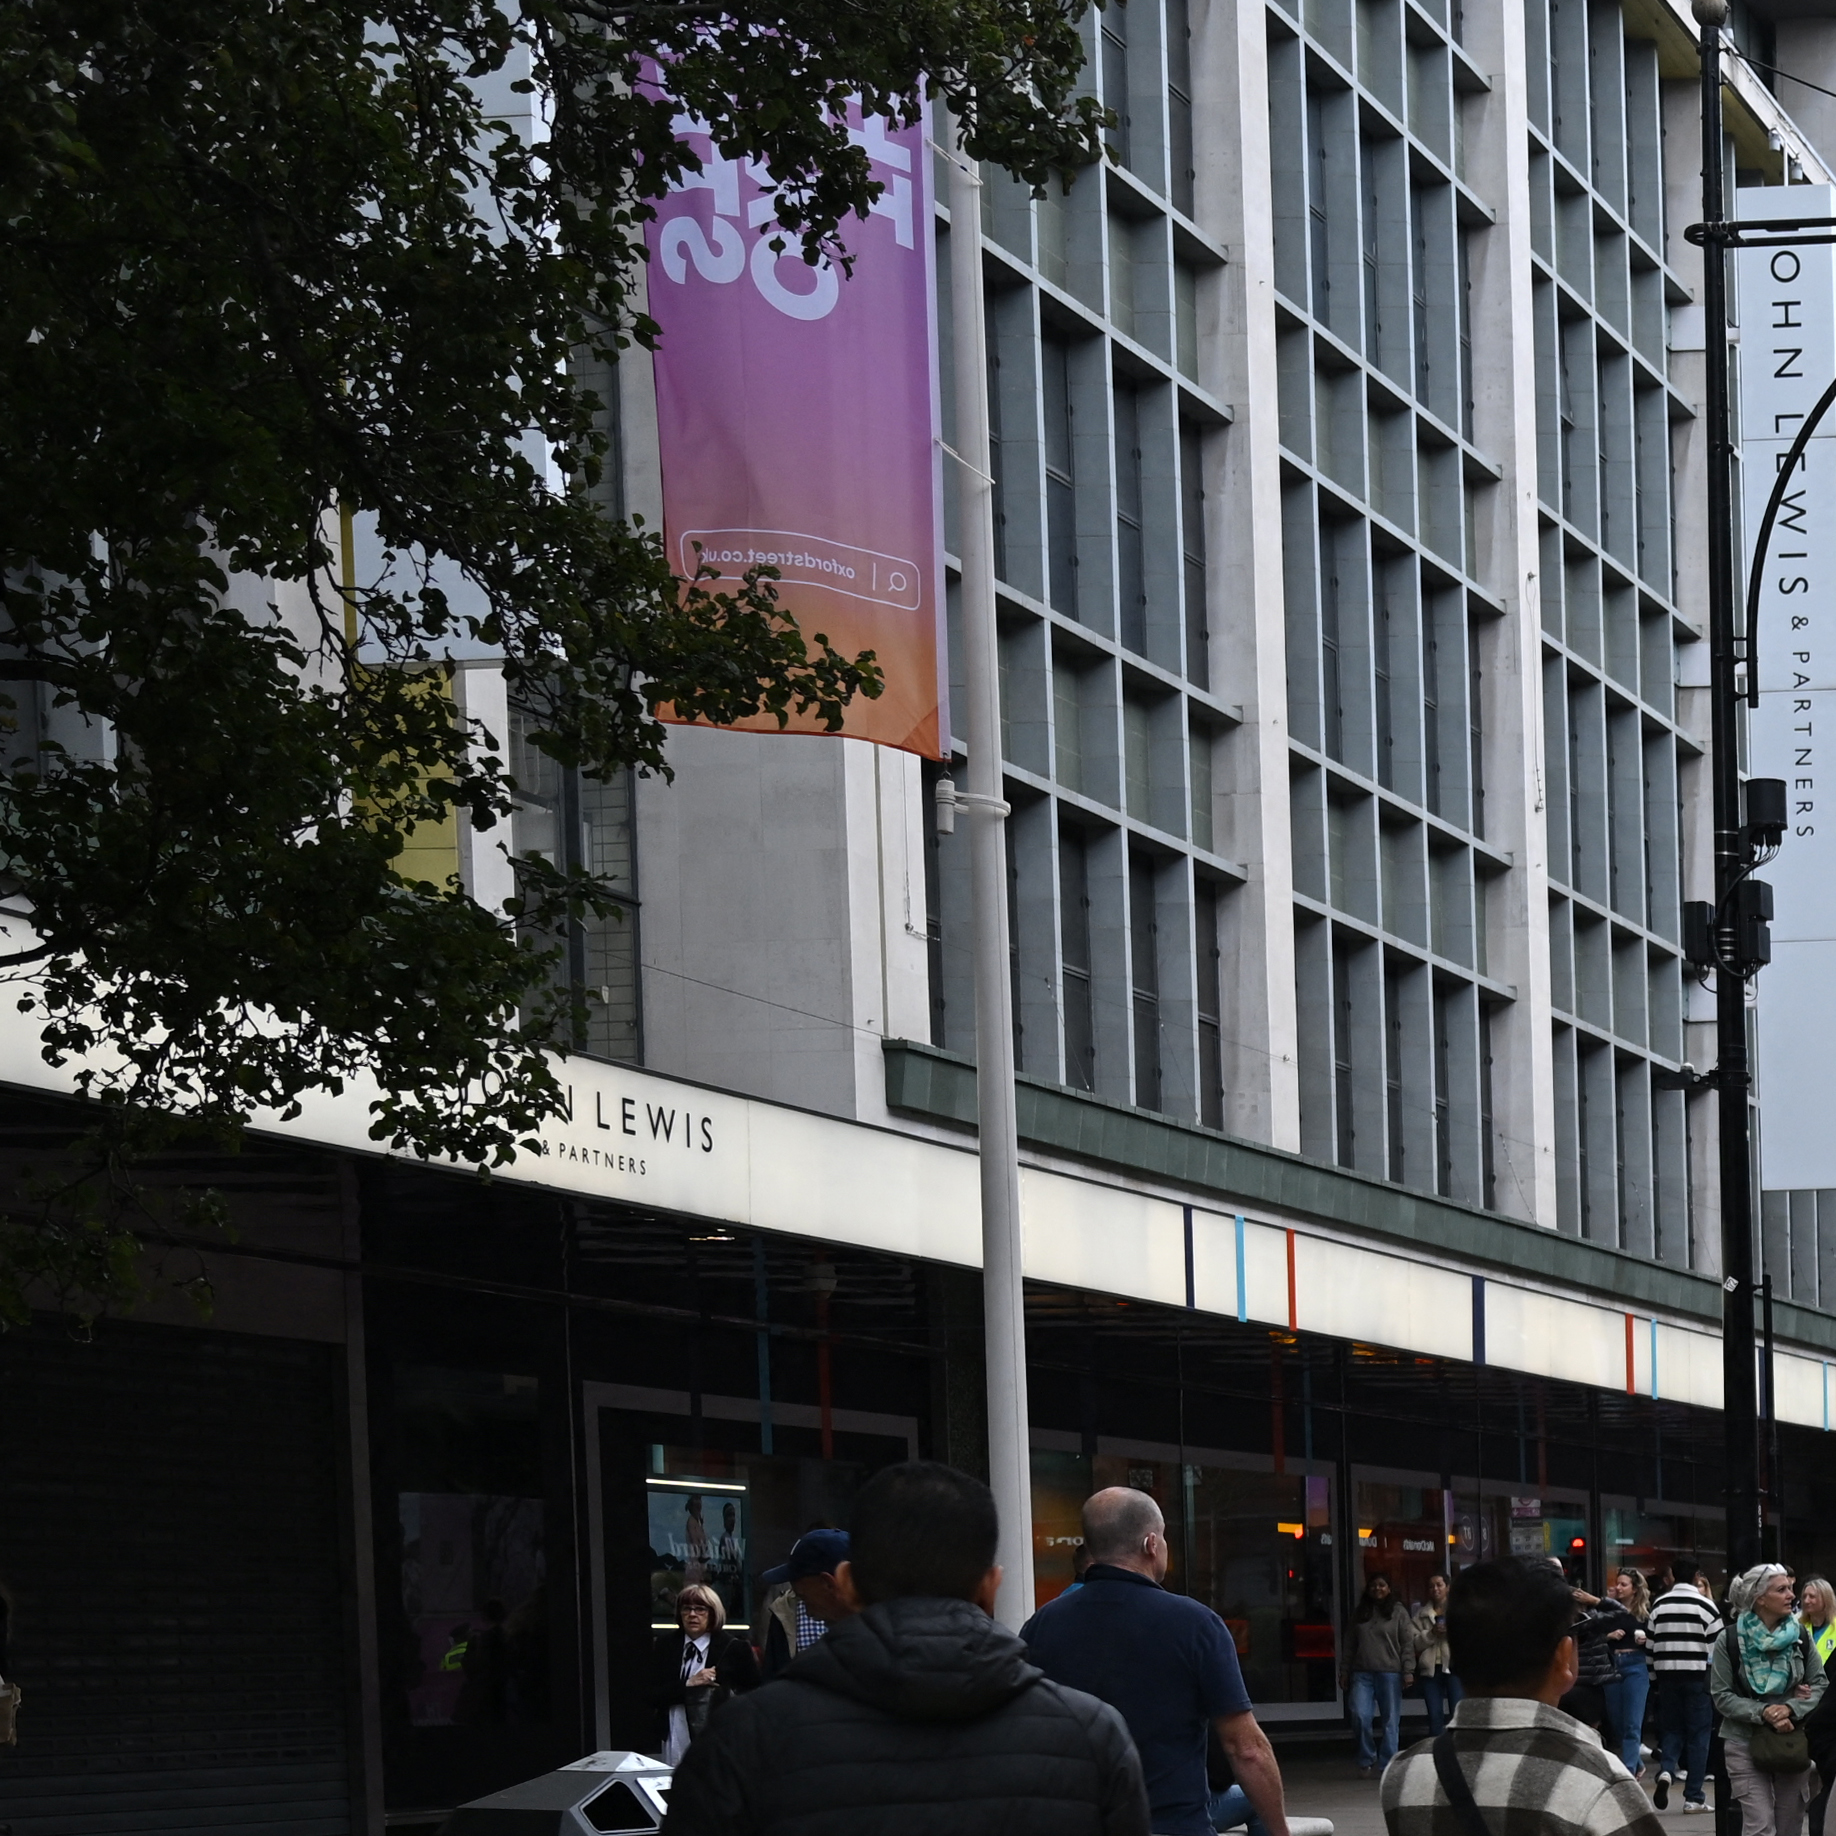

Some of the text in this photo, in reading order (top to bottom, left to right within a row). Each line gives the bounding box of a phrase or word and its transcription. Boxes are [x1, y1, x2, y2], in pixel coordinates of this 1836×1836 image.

[1770, 222, 1815, 838] OHN LEWIS & PARTNERS
[597, 1091, 713, 1153] LEWIS
[559, 1143, 646, 1176] PARTNERS
